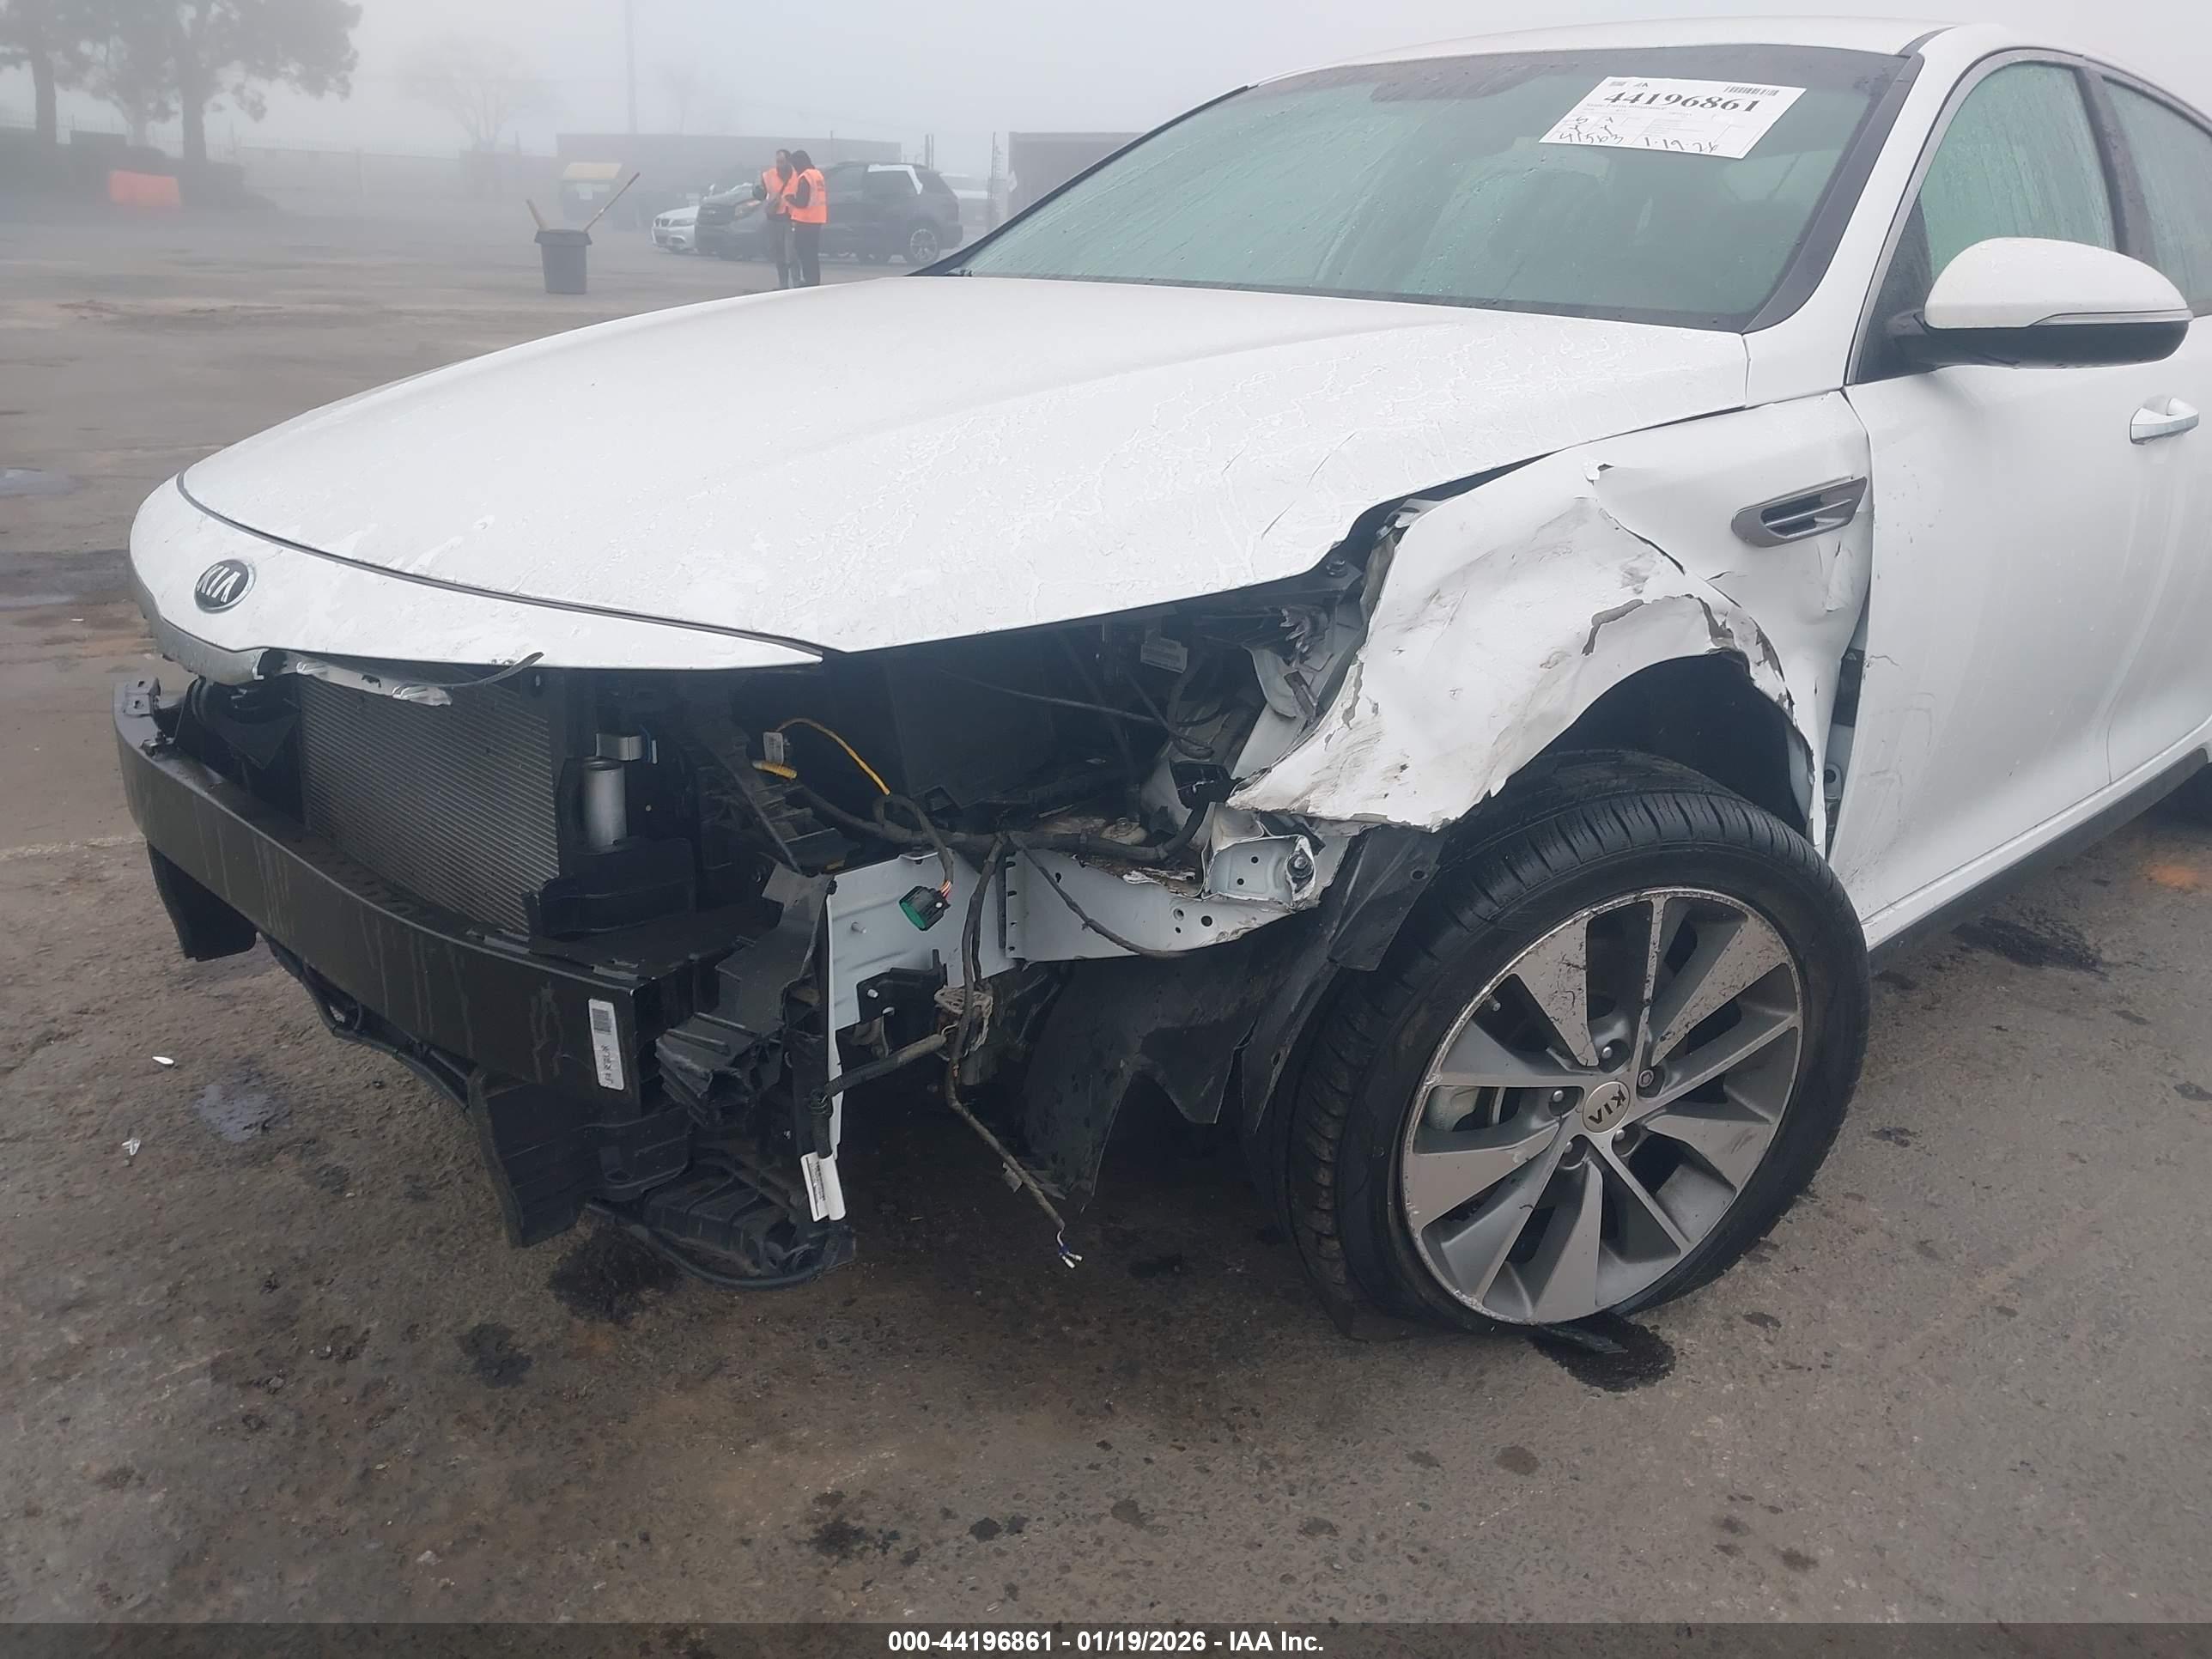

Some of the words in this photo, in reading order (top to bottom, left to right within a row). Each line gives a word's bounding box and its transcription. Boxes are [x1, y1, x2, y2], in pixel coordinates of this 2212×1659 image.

[1604, 91, 1760, 113] 44196861
[196, 564, 241, 604] KIA
[1588, 1085, 1626, 1124] KIA
